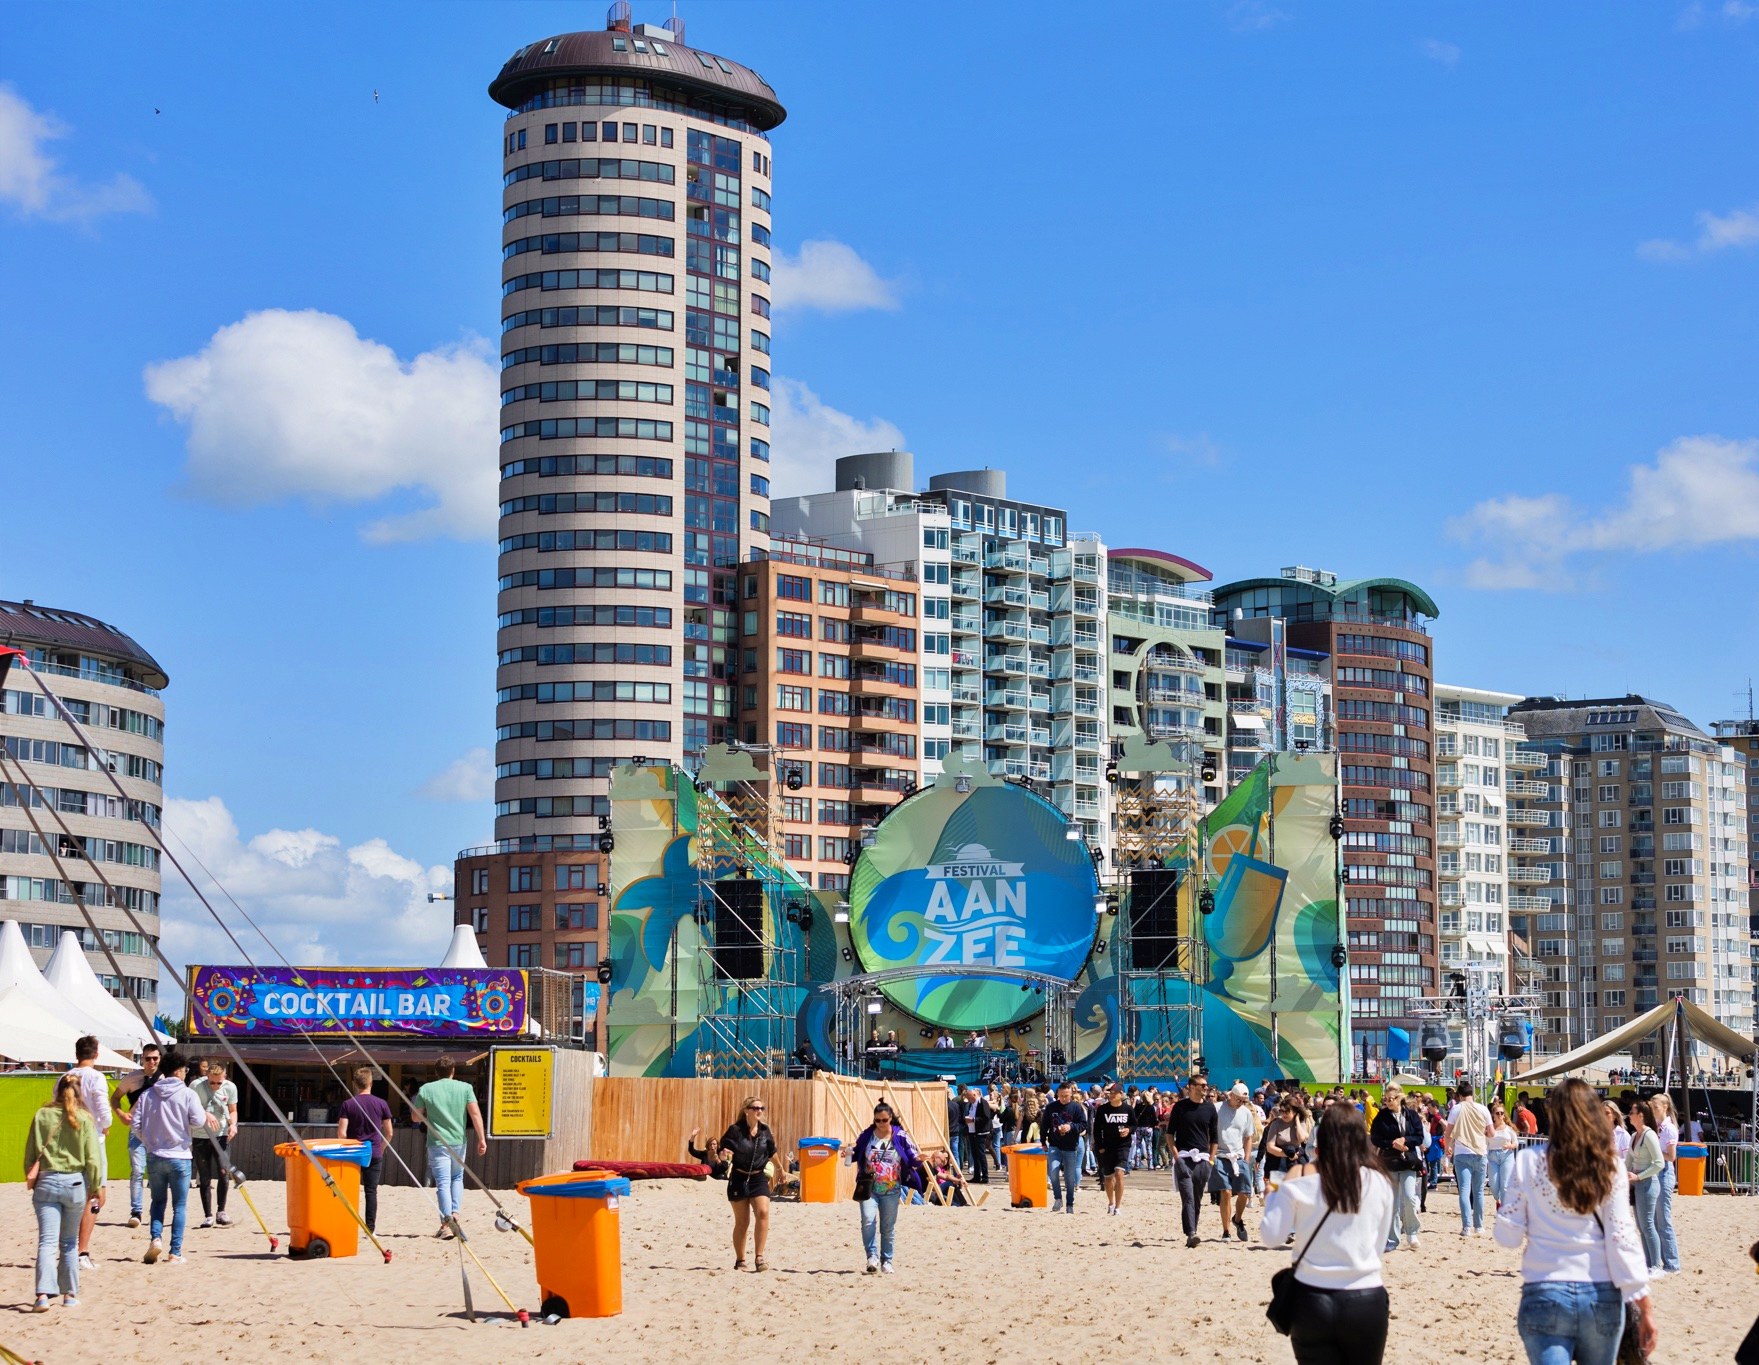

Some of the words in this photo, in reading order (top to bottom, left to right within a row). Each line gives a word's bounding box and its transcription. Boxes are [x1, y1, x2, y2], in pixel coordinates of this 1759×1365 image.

[943, 864, 1007, 877] FESTIVAL
[924, 879, 1027, 922] AAN
[924, 925, 1026, 967] ZEE
[263, 991, 393, 1016] COCKTAIL
[398, 992, 451, 1016] BAR
[510, 1055, 542, 1063] COCKTAILS
[1104, 1113, 1129, 1123] VANS
